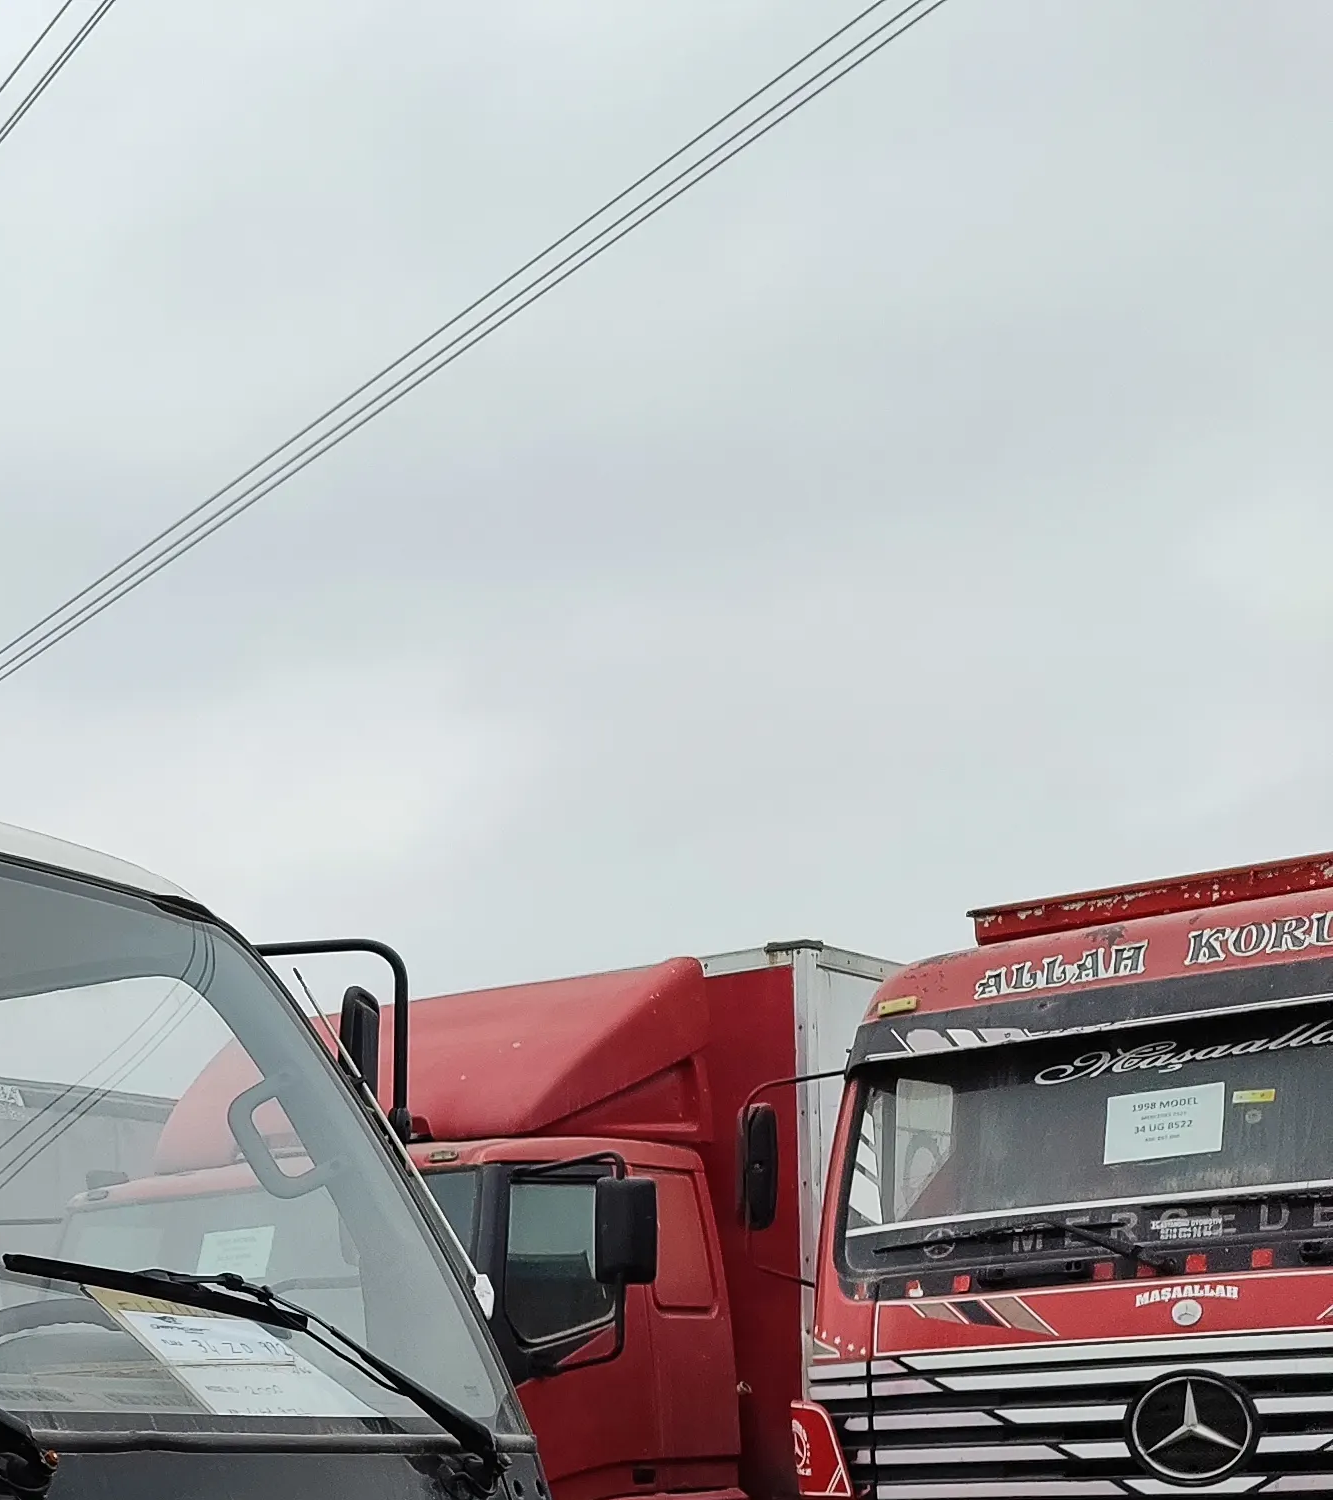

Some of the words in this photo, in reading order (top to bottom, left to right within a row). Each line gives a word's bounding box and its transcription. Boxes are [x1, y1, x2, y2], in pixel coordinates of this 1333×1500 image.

[974, 939, 1149, 1000] ALLAH
[1159, 1096, 1199, 1110] MODEL
[1135, 1284, 1239, 1308] MAŞAALLAH
